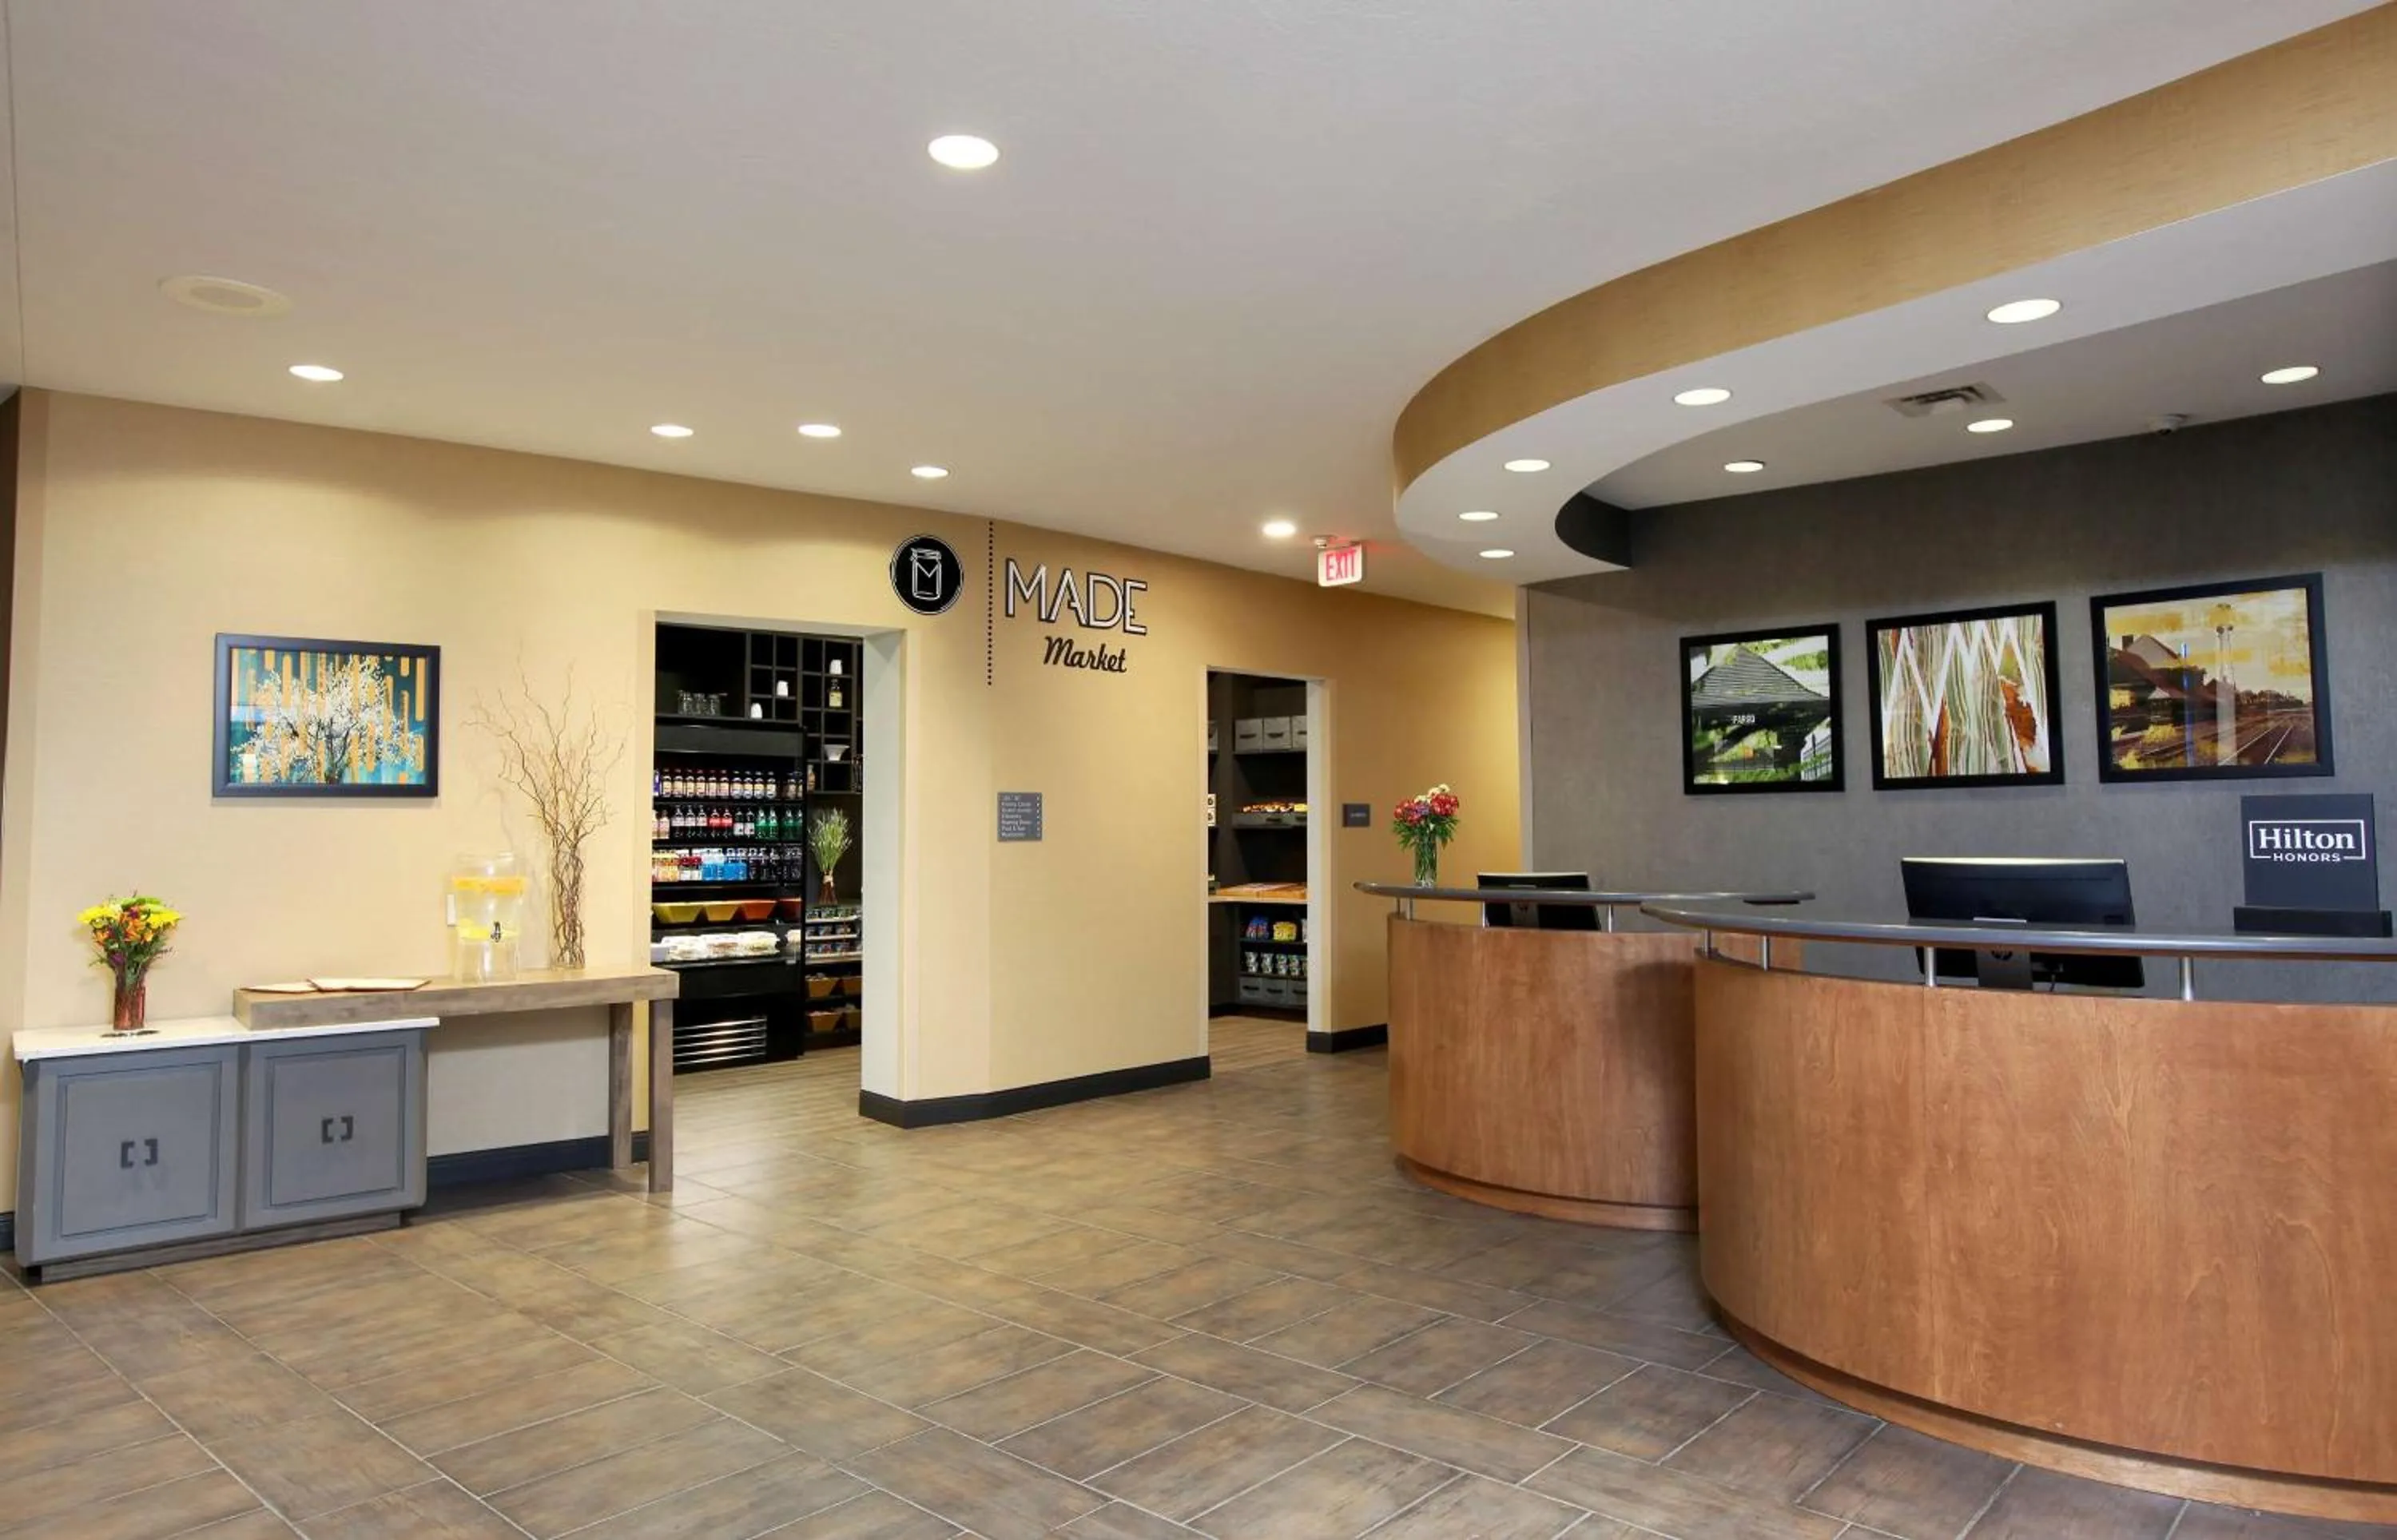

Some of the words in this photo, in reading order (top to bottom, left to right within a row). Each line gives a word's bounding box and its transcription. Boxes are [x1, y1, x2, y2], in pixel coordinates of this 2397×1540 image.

[1326, 546, 1357, 581] EXIT
[1004, 557, 1148, 636] MADE
[1043, 636, 1127, 673] Market
[2258, 828, 2356, 850] Hilton
[2272, 852, 2341, 863] HONORS
